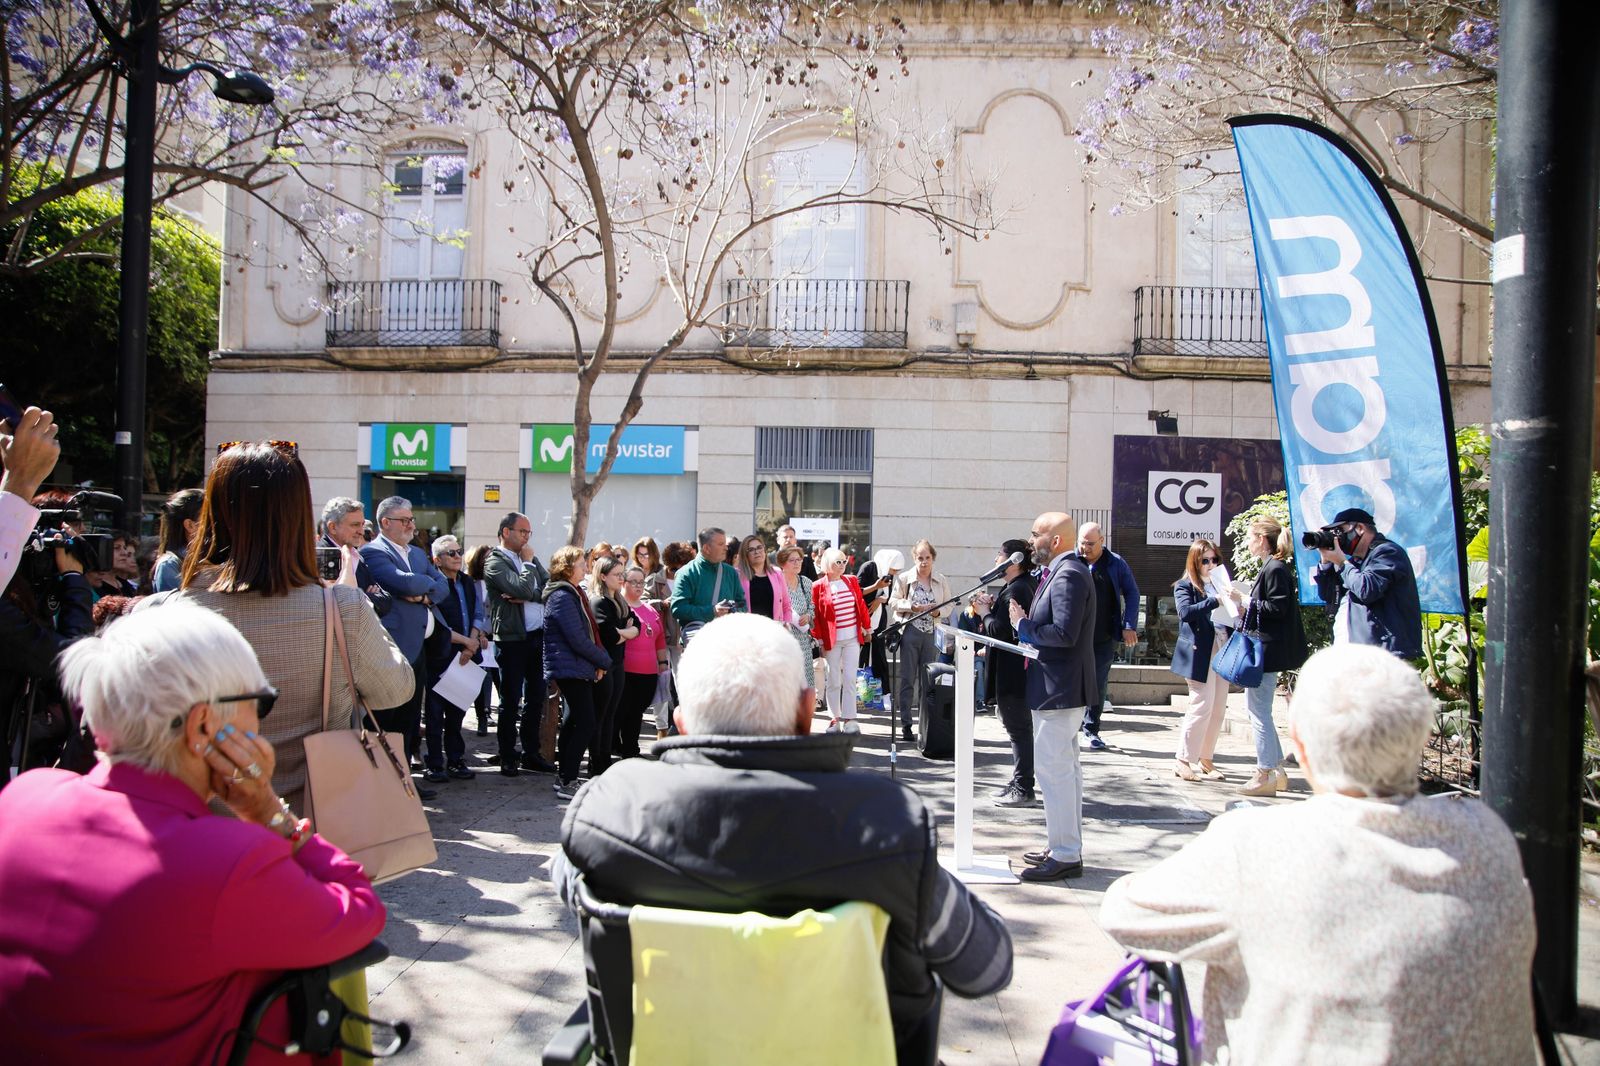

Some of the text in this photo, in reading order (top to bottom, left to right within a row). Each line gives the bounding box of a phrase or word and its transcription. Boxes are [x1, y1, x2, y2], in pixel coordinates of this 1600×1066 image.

[391, 458, 428, 467] movistar
[1154, 478, 1215, 515] CG
[1153, 529, 1188, 540] consuelo
